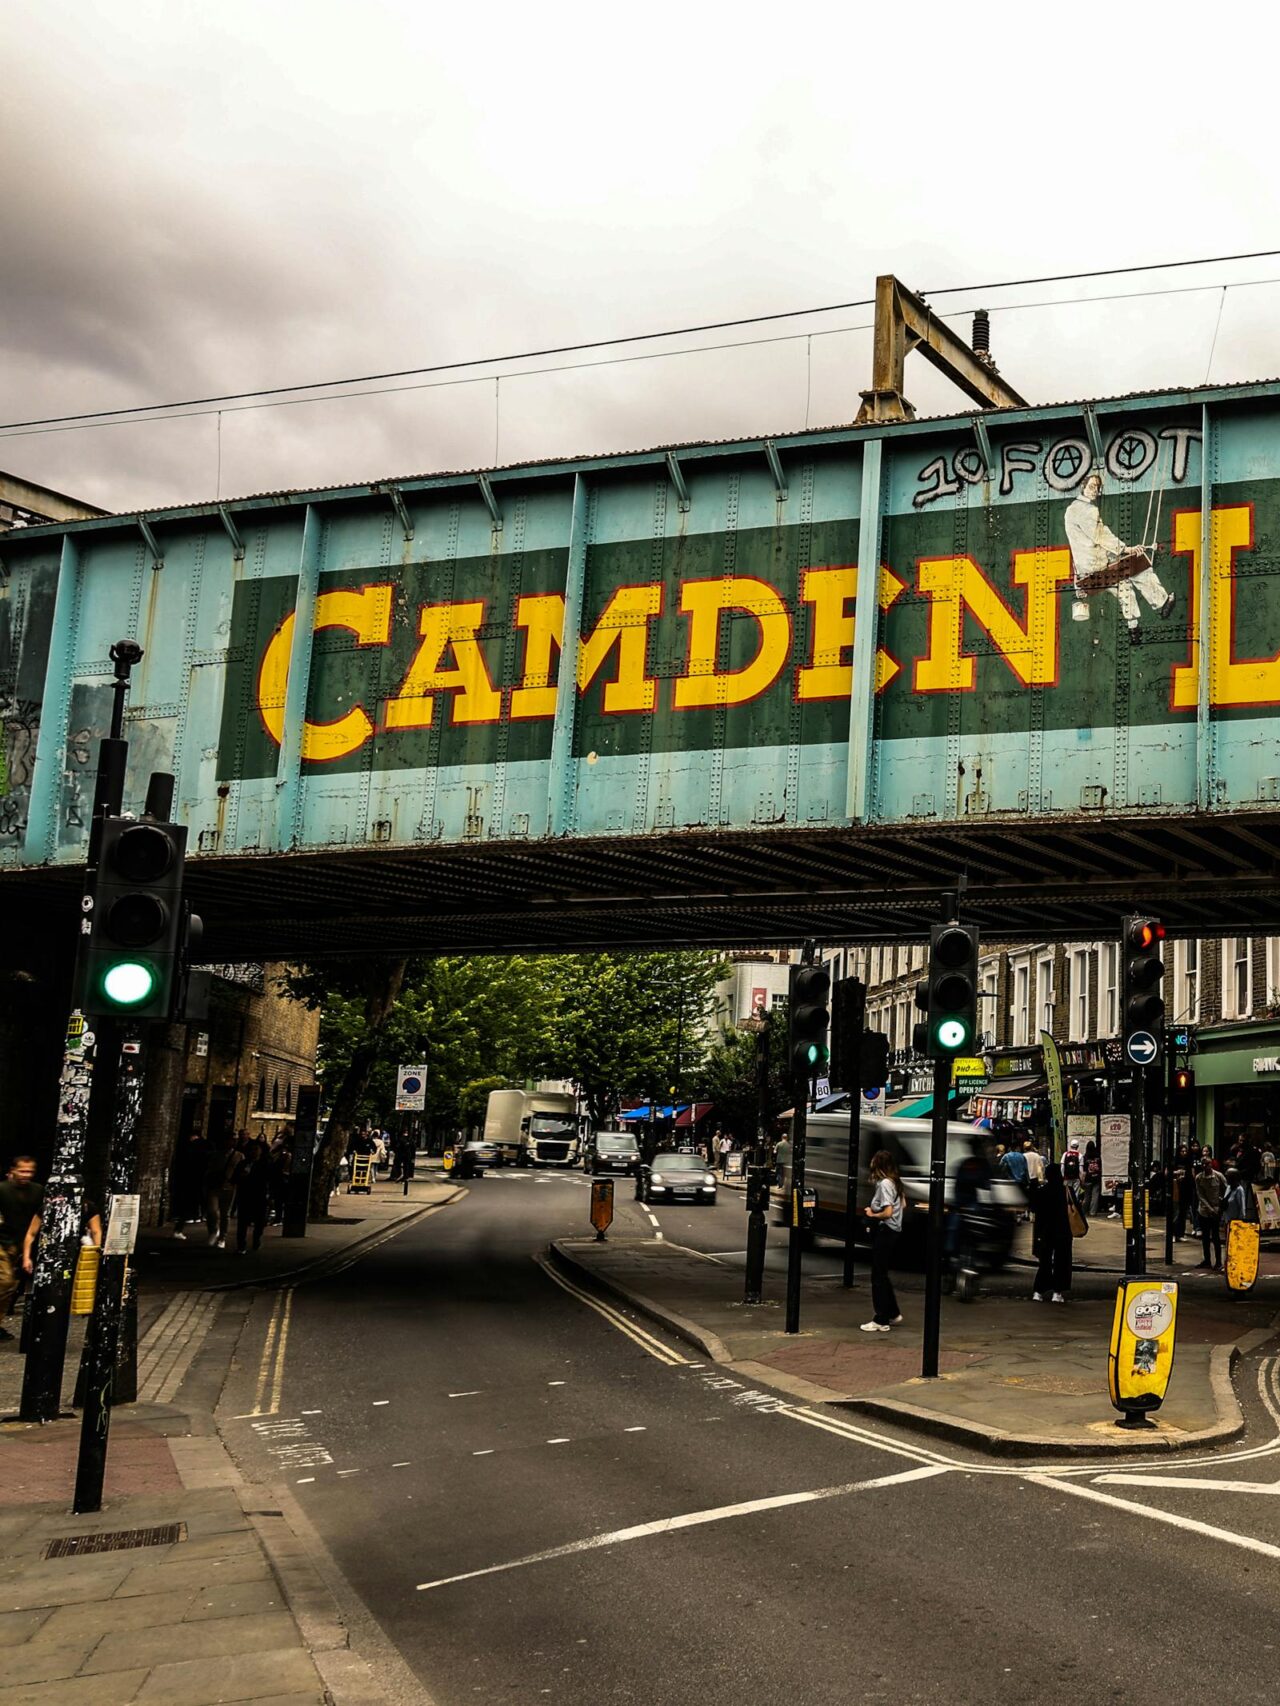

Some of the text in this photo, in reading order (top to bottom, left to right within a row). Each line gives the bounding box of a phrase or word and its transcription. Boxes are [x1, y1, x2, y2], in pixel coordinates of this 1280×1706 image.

[257, 545, 1075, 765] CAMDEN
[958, 1078, 968, 1086] OFF
[958, 1086, 974, 1094] OPEN
